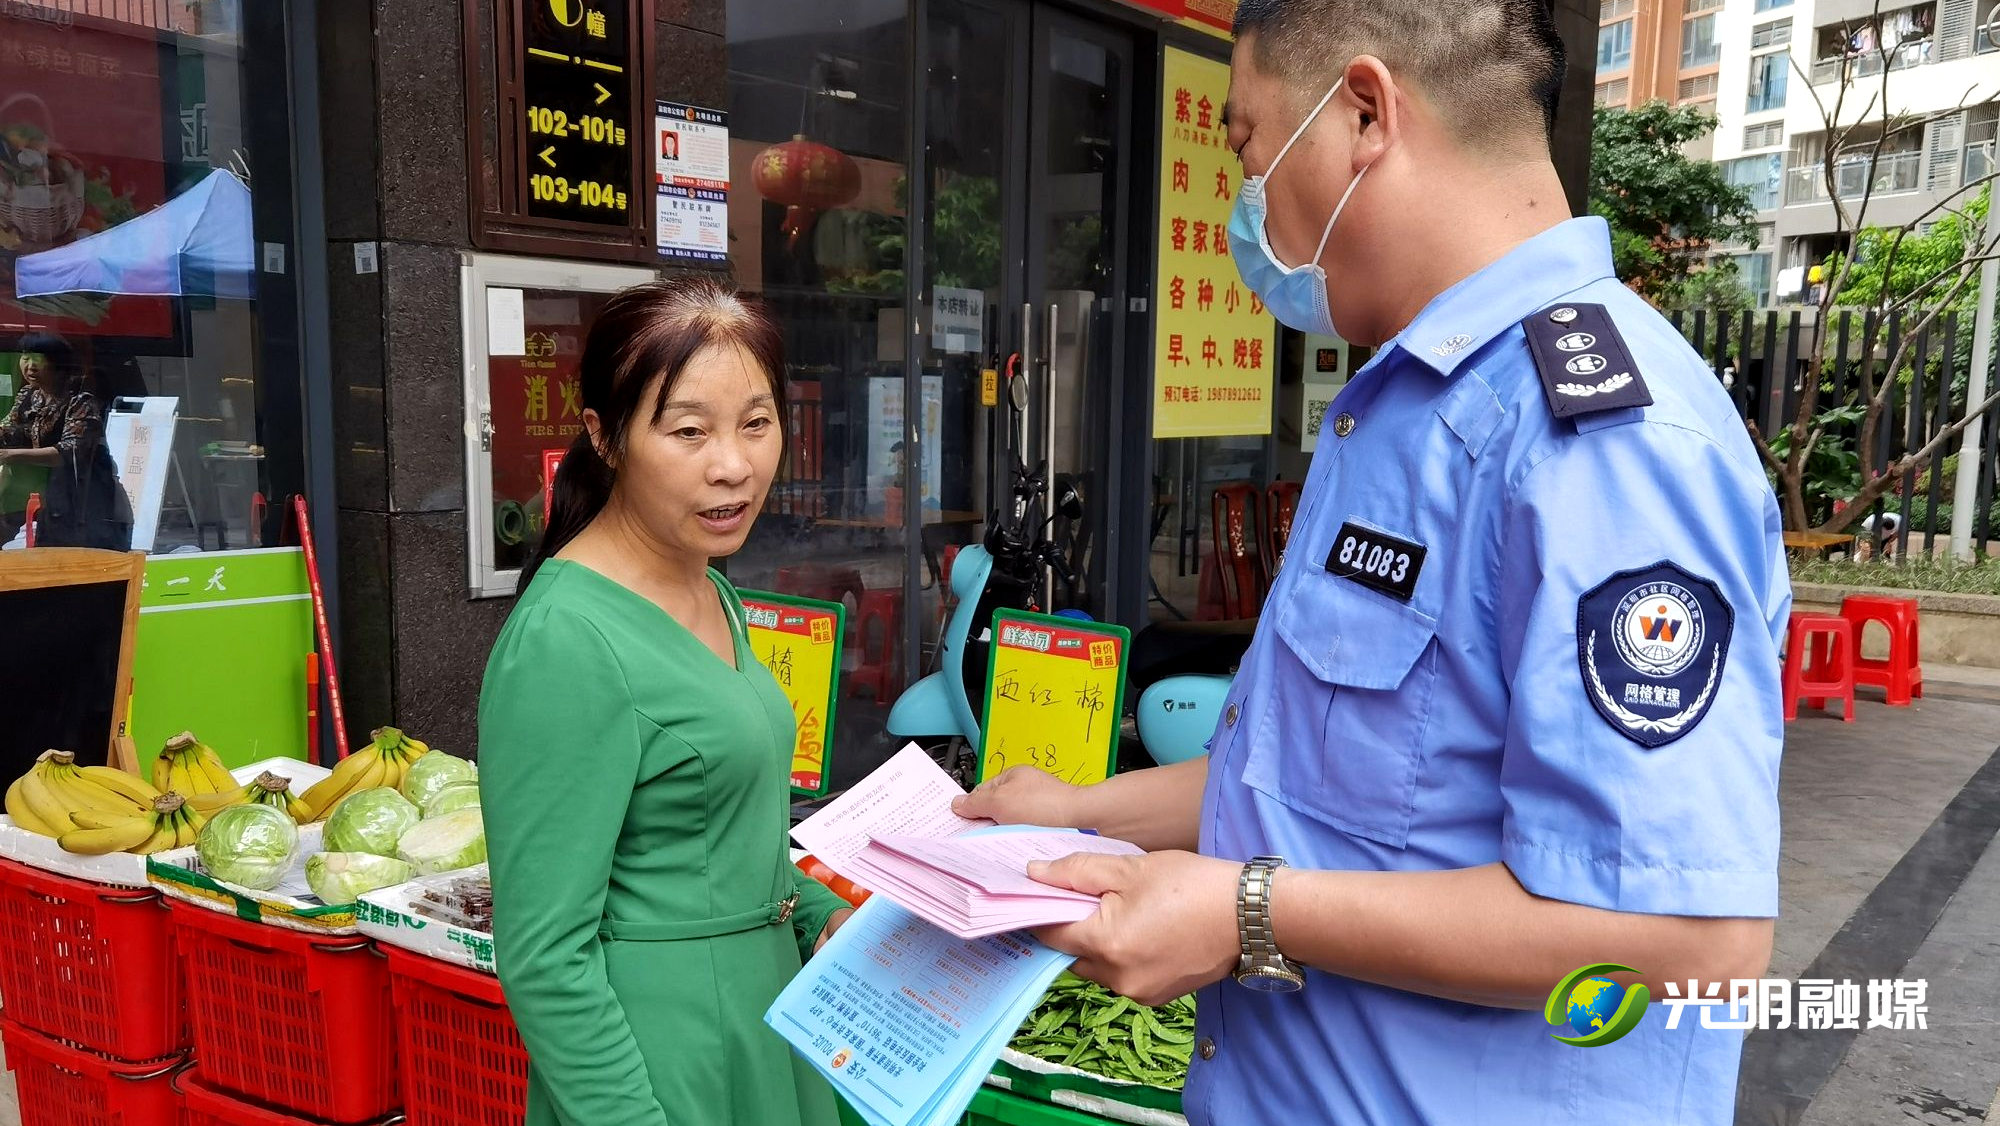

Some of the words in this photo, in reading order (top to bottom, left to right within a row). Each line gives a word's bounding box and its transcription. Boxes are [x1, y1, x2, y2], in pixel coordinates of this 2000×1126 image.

[587, 9, 606, 38] 幢
[1175, 87, 1226, 131] 紫金
[528, 106, 625, 145] 102-101号
[530, 174, 627, 210] 103-104号
[1173, 157, 1230, 201] 肉丸
[1171, 216, 1229, 257] 客家私
[937, 295, 980, 317] 本店转让
[523, 374, 583, 421] 消火
[525, 425, 554, 436] FIRE
[1339, 536, 1410, 584] 81083
[1092, 643, 1112, 655] 特价
[1093, 655, 1114, 667] 商品
[1624, 683, 1681, 702] 网格管理
[811, 1032, 836, 1056] POLICE
[845, 1059, 867, 1081] 公安
